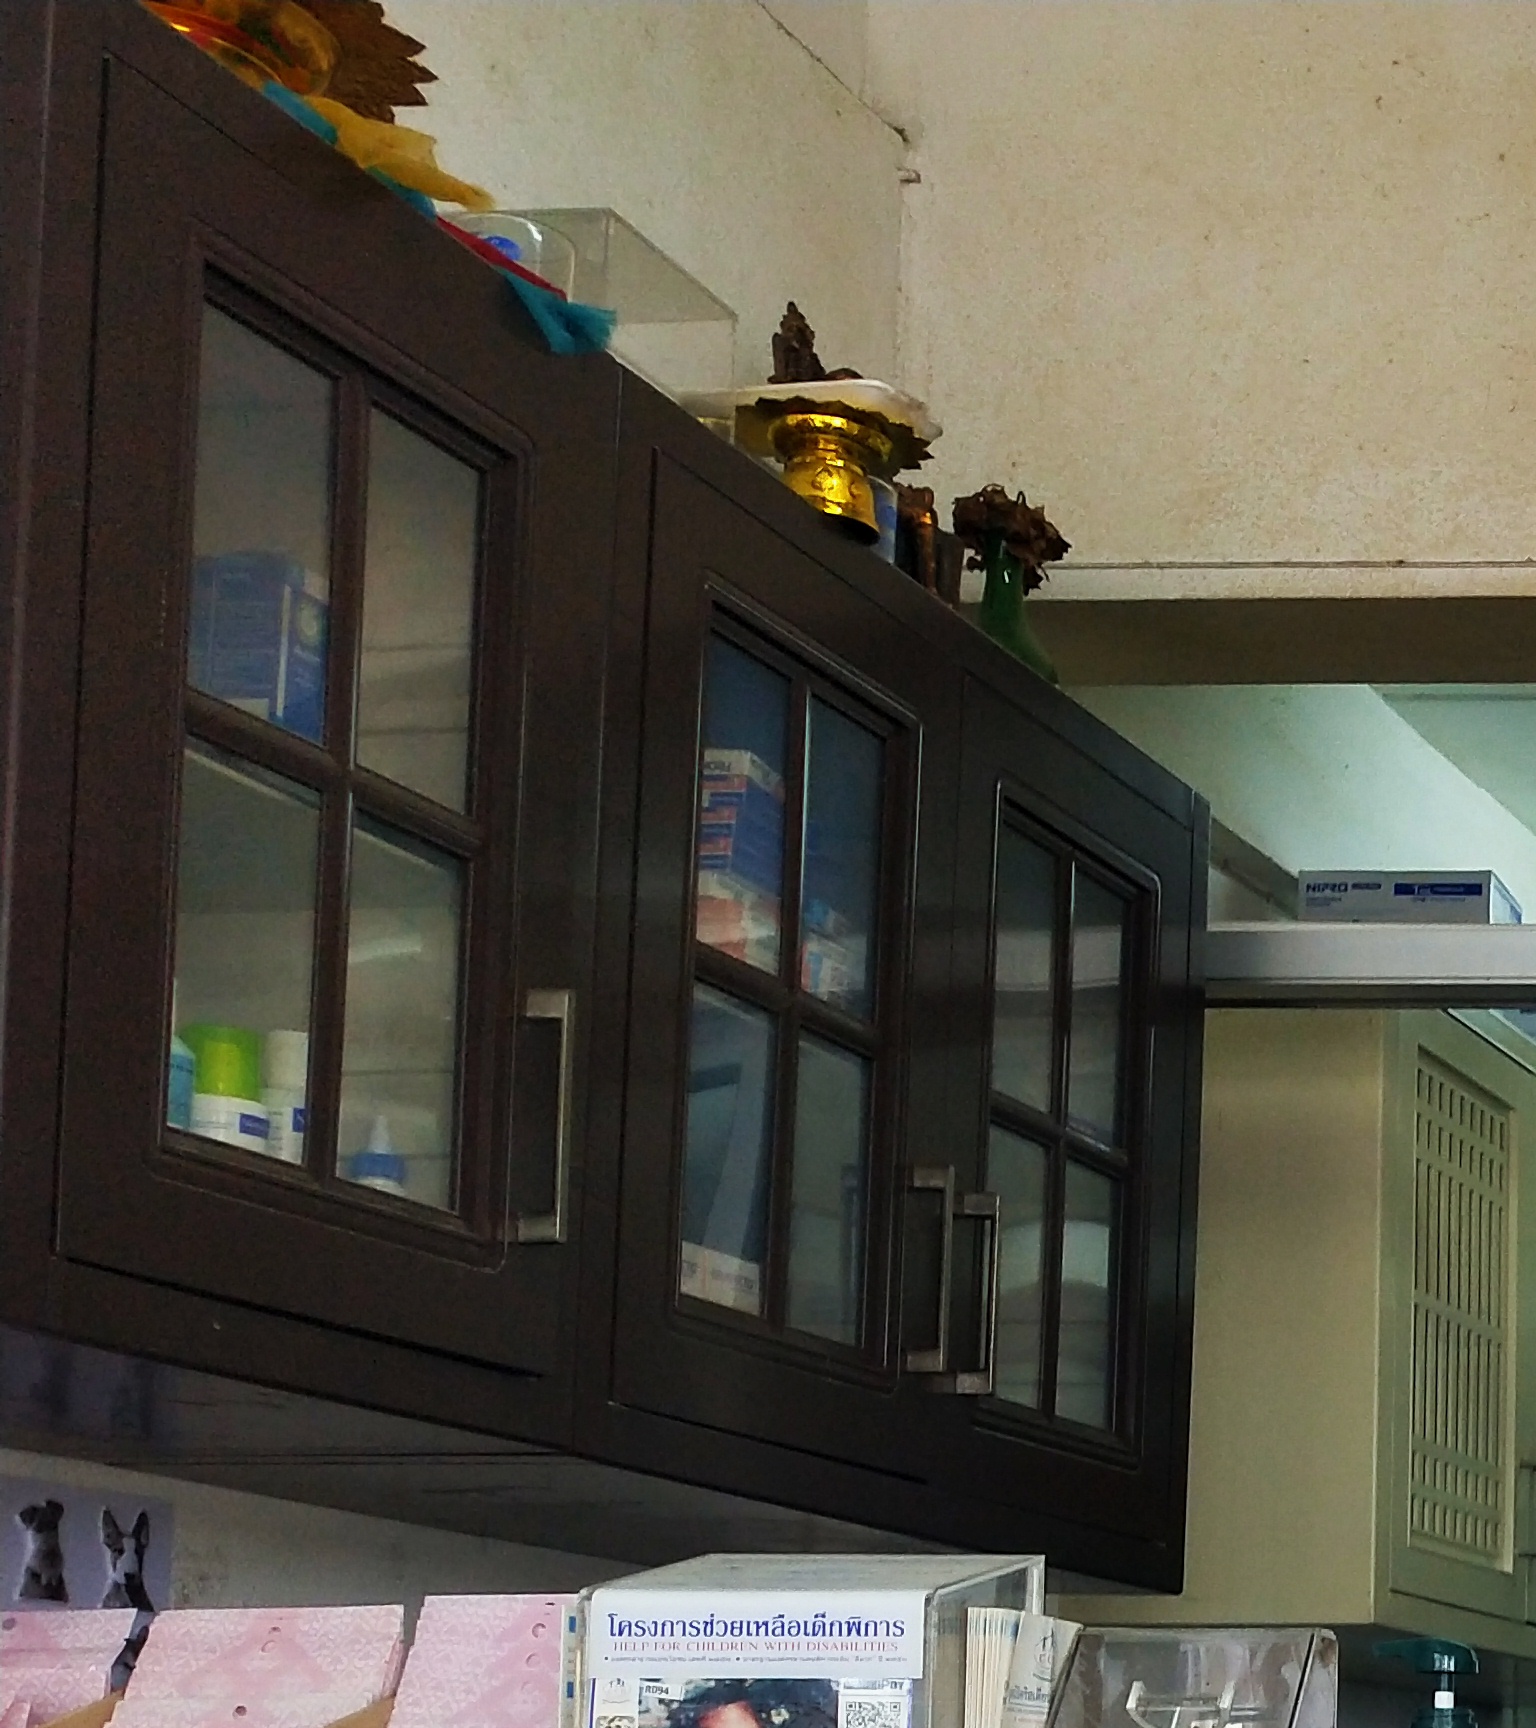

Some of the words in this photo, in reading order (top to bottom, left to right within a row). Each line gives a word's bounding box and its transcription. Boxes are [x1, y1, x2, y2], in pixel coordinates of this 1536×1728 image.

[1306, 882, 1348, 893] NIPRO
[607, 1611, 906, 1639] โครงการช่วยเหลือเด็กพิการ
[613, 1641, 651, 1652] HELP
[654, 1641, 681, 1652] FOR
[686, 1641, 759, 1652] CHILDREN
[765, 1641, 801, 1652] WITH
[806, 1641, 899, 1652] DISABILITIES
